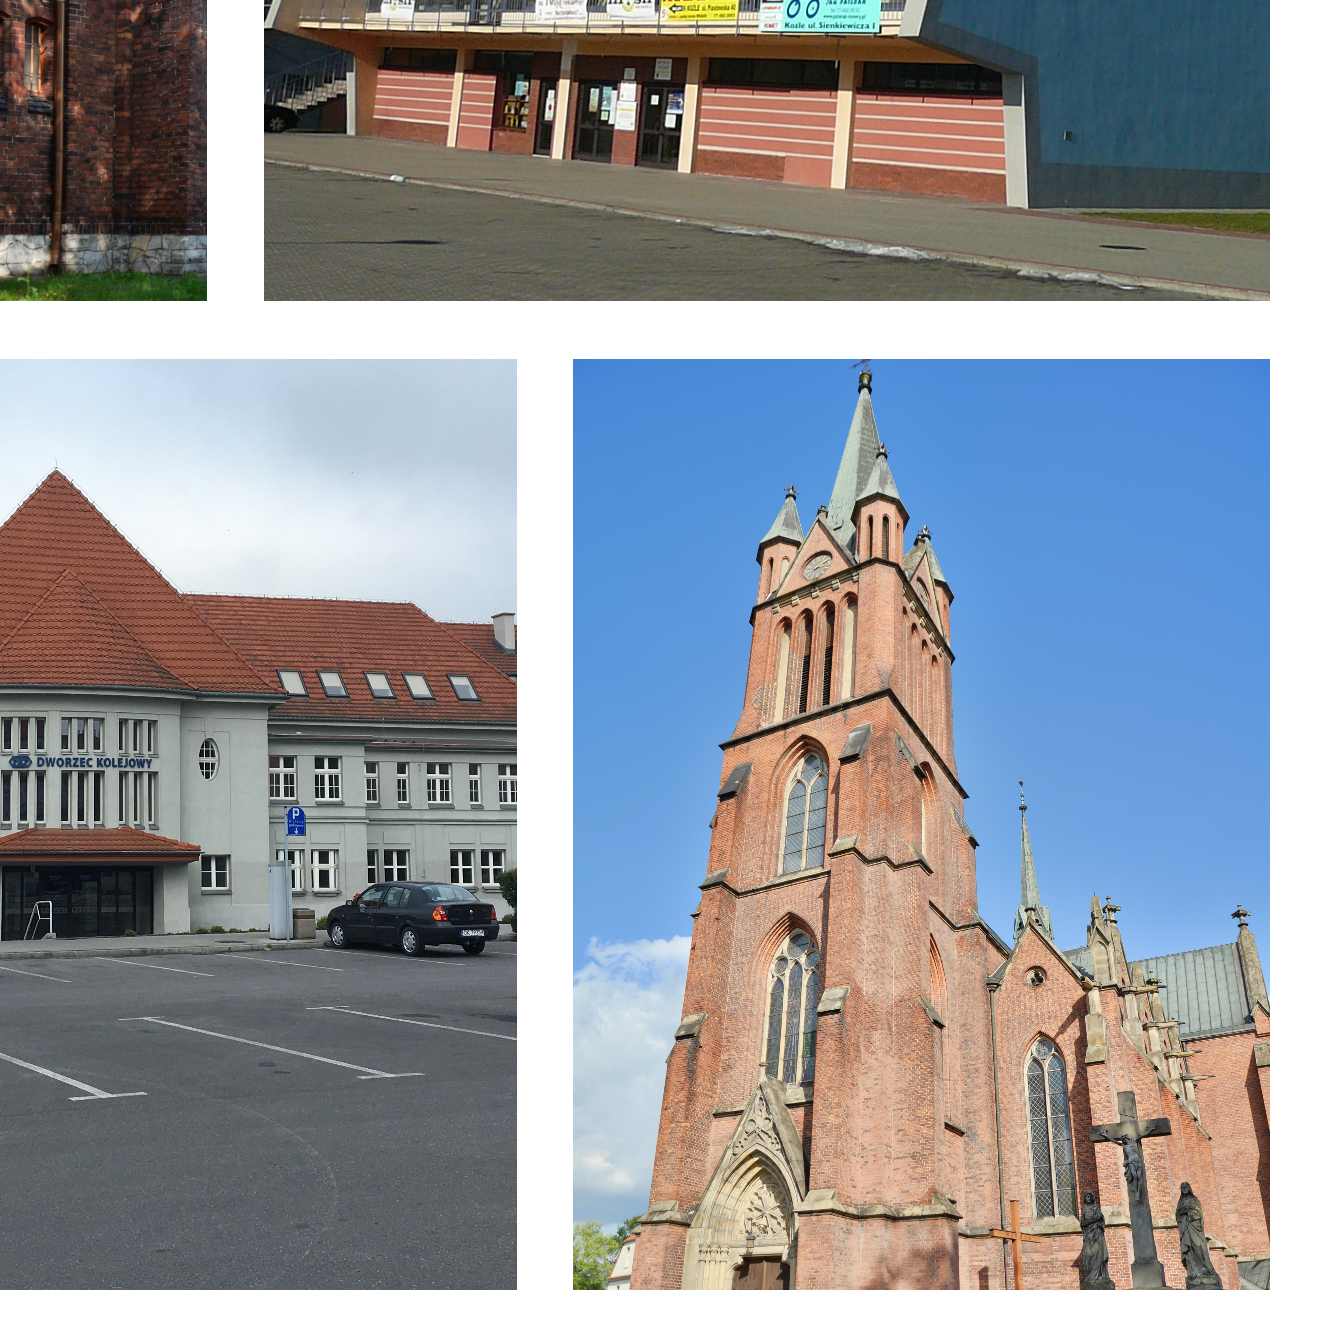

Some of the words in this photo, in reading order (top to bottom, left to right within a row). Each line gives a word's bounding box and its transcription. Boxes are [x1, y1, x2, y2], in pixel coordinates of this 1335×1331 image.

[819, 21, 870, 29] Sienkiewicza
[37, 757, 93, 768] DWORZEC
[97, 757, 153, 769] KOLEJOWY
[292, 808, 299, 819] P
